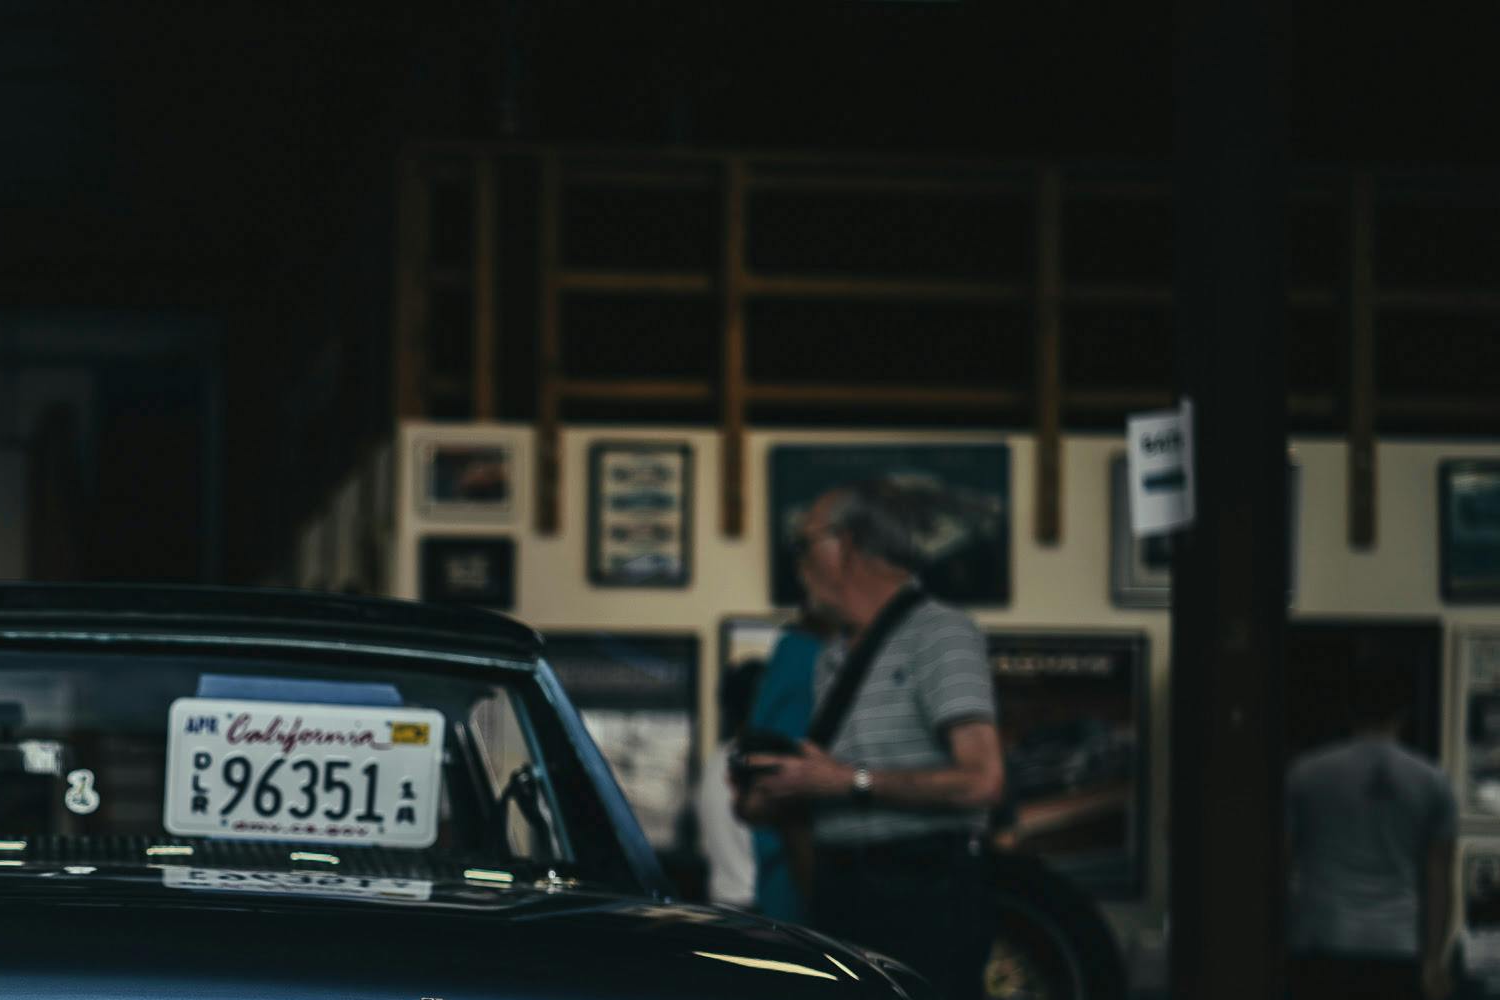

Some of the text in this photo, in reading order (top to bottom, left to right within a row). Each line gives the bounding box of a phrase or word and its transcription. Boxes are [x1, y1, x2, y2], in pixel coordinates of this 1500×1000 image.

[184, 716, 219, 735] APR
[227, 712, 393, 754] California
[220, 756, 384, 823] 96351
